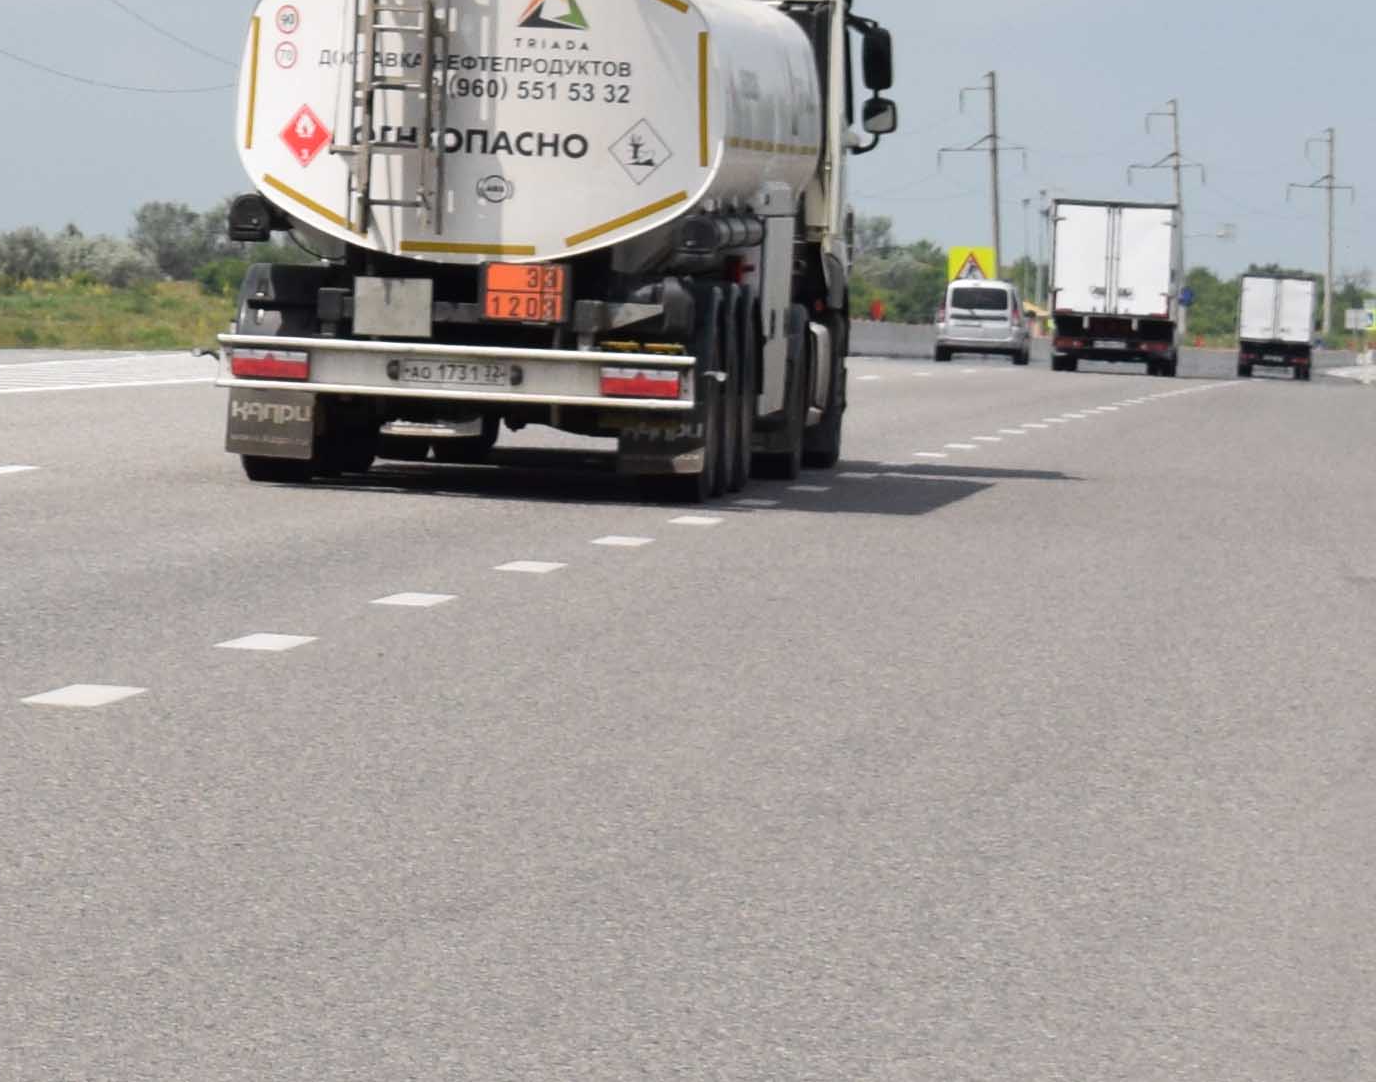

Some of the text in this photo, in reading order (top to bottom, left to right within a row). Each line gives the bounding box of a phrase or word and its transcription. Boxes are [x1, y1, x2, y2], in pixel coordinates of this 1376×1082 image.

[514, 37, 590, 51] TRIADA
[318, 49, 423, 68] ДОСАВКА
[448, 73, 508, 101] (960)
[516, 80, 558, 101] 551
[568, 82, 595, 103] 53
[603, 84, 630, 104] 32
[351, 124, 589, 159] ОГНОПАСНО
[527, 268, 558, 288] 33
[492, 296, 557, 318] 1203
